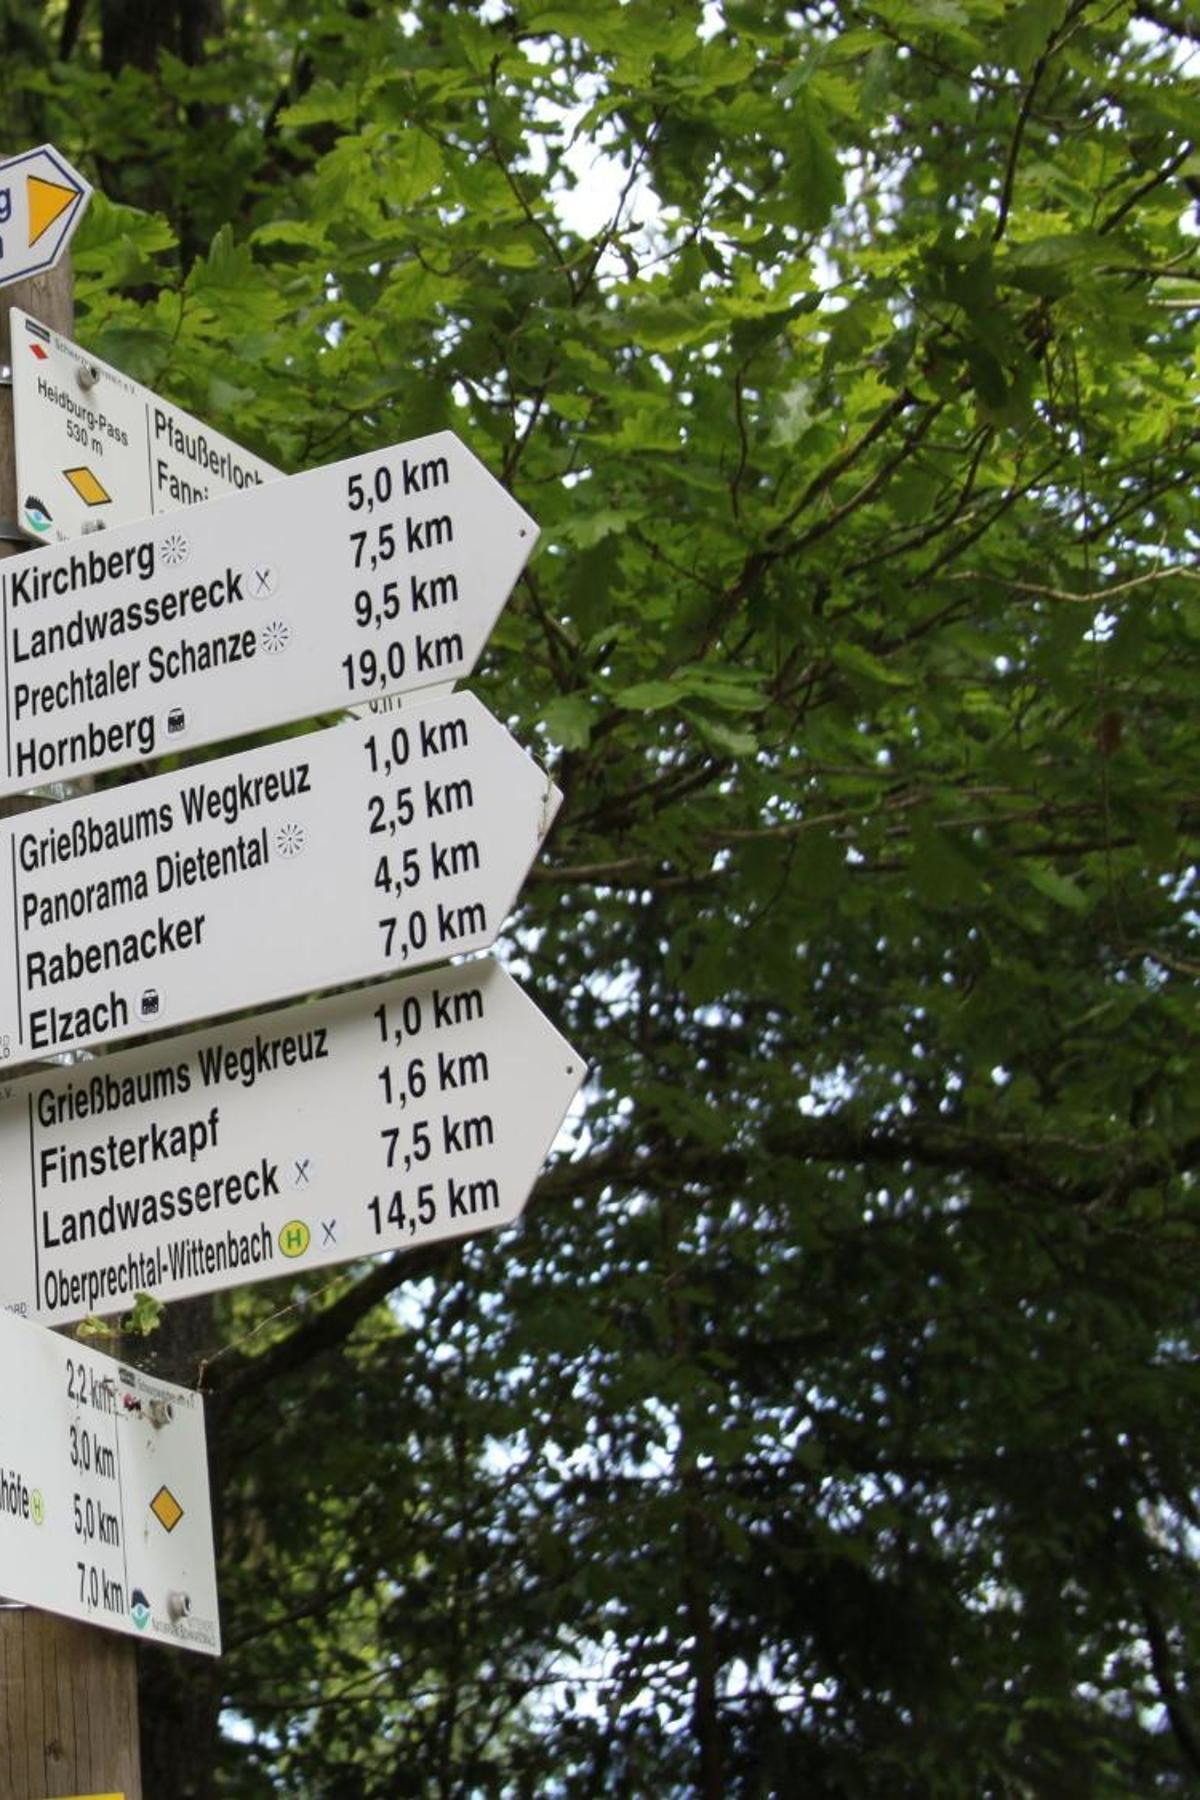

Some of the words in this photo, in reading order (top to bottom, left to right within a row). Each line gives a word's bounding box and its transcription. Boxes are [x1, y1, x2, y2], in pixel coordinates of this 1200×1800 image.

[37, 377, 129, 446] Heidburg-Pass
[66, 420, 88, 446] 530
[92, 439, 104, 456] m
[11, 541, 155, 607] Kirchberg
[348, 466, 392, 513] 5,0
[402, 456, 449, 495] km
[13, 568, 244, 663] Landwassereck
[349, 523, 395, 571] 7,5
[406, 514, 453, 553] km
[14, 659, 140, 720] Prechtaler
[148, 629, 257, 683] Schanze
[354, 582, 400, 630] 9,5
[410, 573, 458, 612] km
[16, 714, 155, 777] Hornberg
[342, 641, 405, 690] 19,0
[415, 632, 464, 671] km
[20, 803, 173, 872] Grießbaums
[180, 763, 311, 825] Wegkreuz
[364, 727, 409, 777] 1,0
[419, 718, 468, 757] km
[23, 870, 148, 931] Panorama
[156, 827, 269, 893] Dietental
[367, 787, 414, 837] 2,5
[424, 778, 473, 818] km
[27, 914, 205, 990] Rabenacker
[374, 848, 420, 898] 4,5
[431, 840, 479, 880] km
[29, 991, 128, 1050] Elzach
[379, 910, 426, 960] 7,0
[437, 902, 486, 942] km
[37, 1062, 191, 1127] Grießbaums
[198, 1027, 329, 1087] Wegkreuz
[374, 996, 421, 1047] 1,0
[432, 988, 483, 1028] km
[40, 1107, 219, 1188] Finsterkapf
[378, 1058, 426, 1110] 1,6
[438, 1050, 488, 1091] km
[43, 1158, 280, 1248] Landwassereck
[381, 1121, 431, 1172] 7,5
[443, 1114, 493, 1154] km
[44, 1222, 273, 1311] Oberprechtal-Wittenbach
[367, 1184, 436, 1236] 14,5
[448, 1177, 500, 1218] km
[66, 1358, 87, 1408] 2,2
[69, 1425, 90, 1475] 3,0
[94, 1433, 116, 1480] km
[73, 1493, 94, 1544] 5,0
[97, 1501, 120, 1547] km
[77, 1561, 99, 1613] 7,0
[102, 1568, 124, 1615] km
